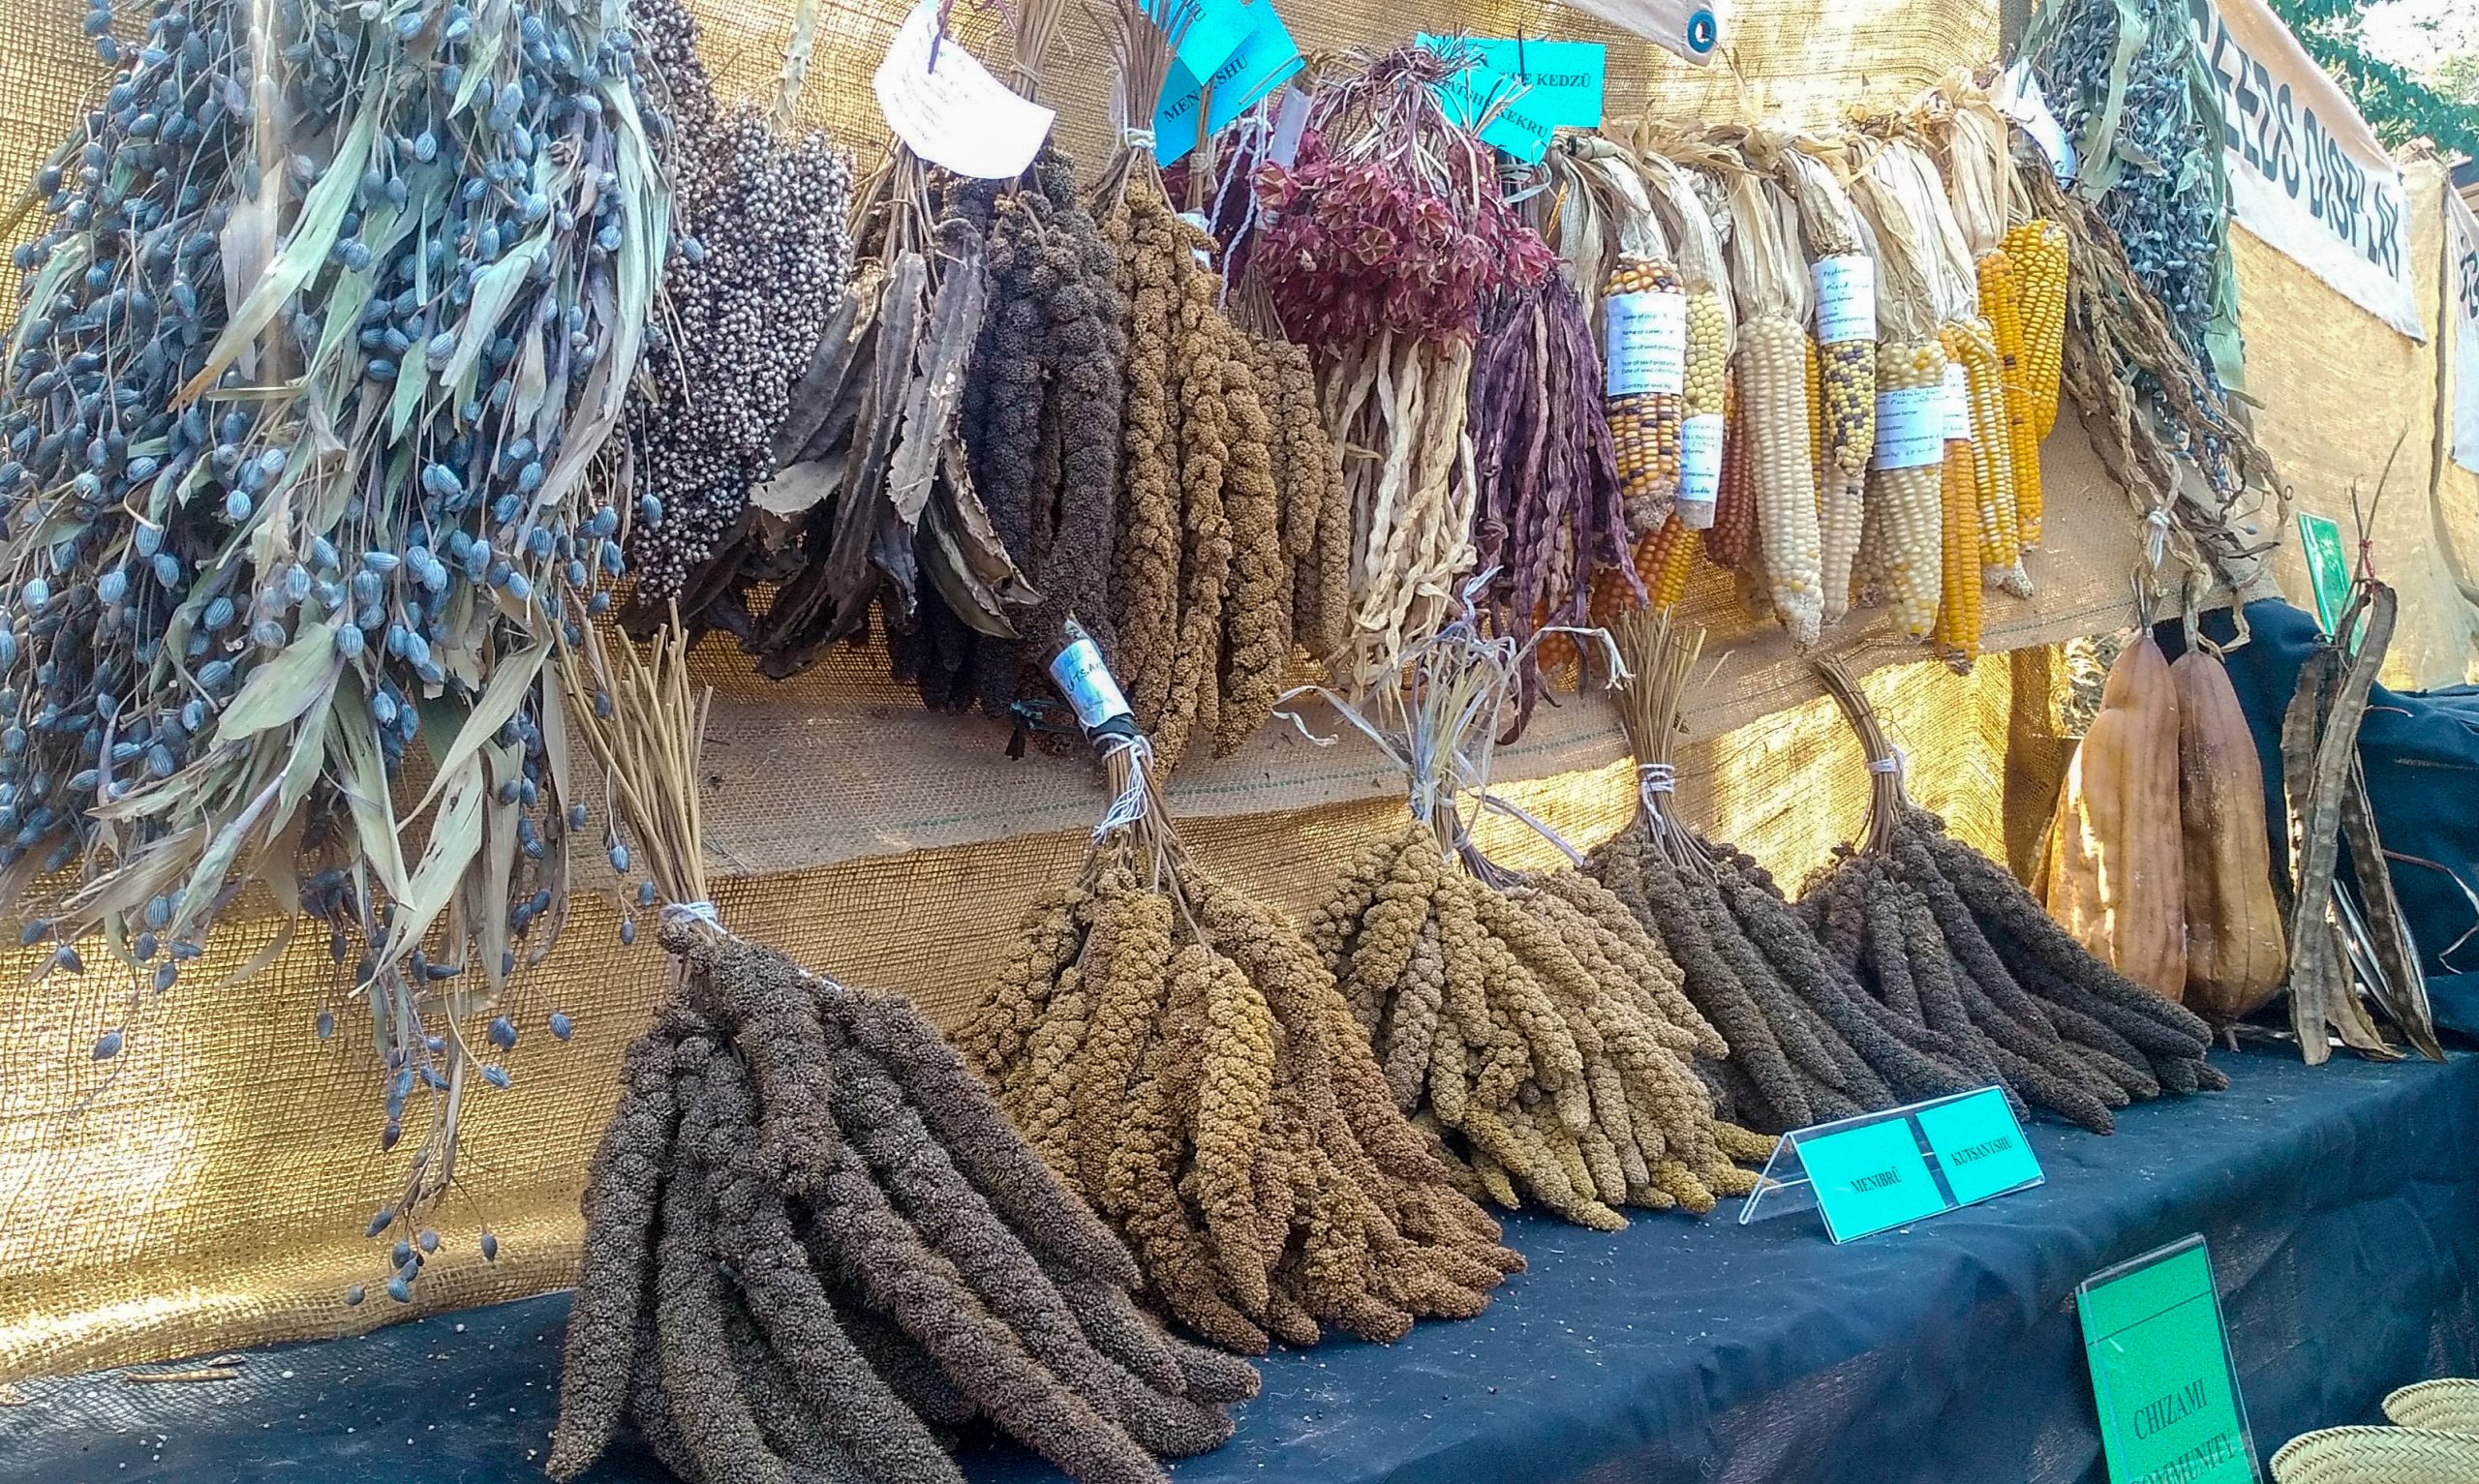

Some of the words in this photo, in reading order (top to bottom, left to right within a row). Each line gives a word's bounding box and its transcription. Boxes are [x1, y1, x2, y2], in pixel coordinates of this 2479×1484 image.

[1536, 73, 1591, 88] KEDZÜ
[2303, 106, 2400, 283] DISPLAY
[1950, 1135, 2013, 1167] KUTSANTSHU
[1851, 1166, 1902, 1195] MENIBRÜ
[2133, 1378, 2208, 1440] CHIZAMI
